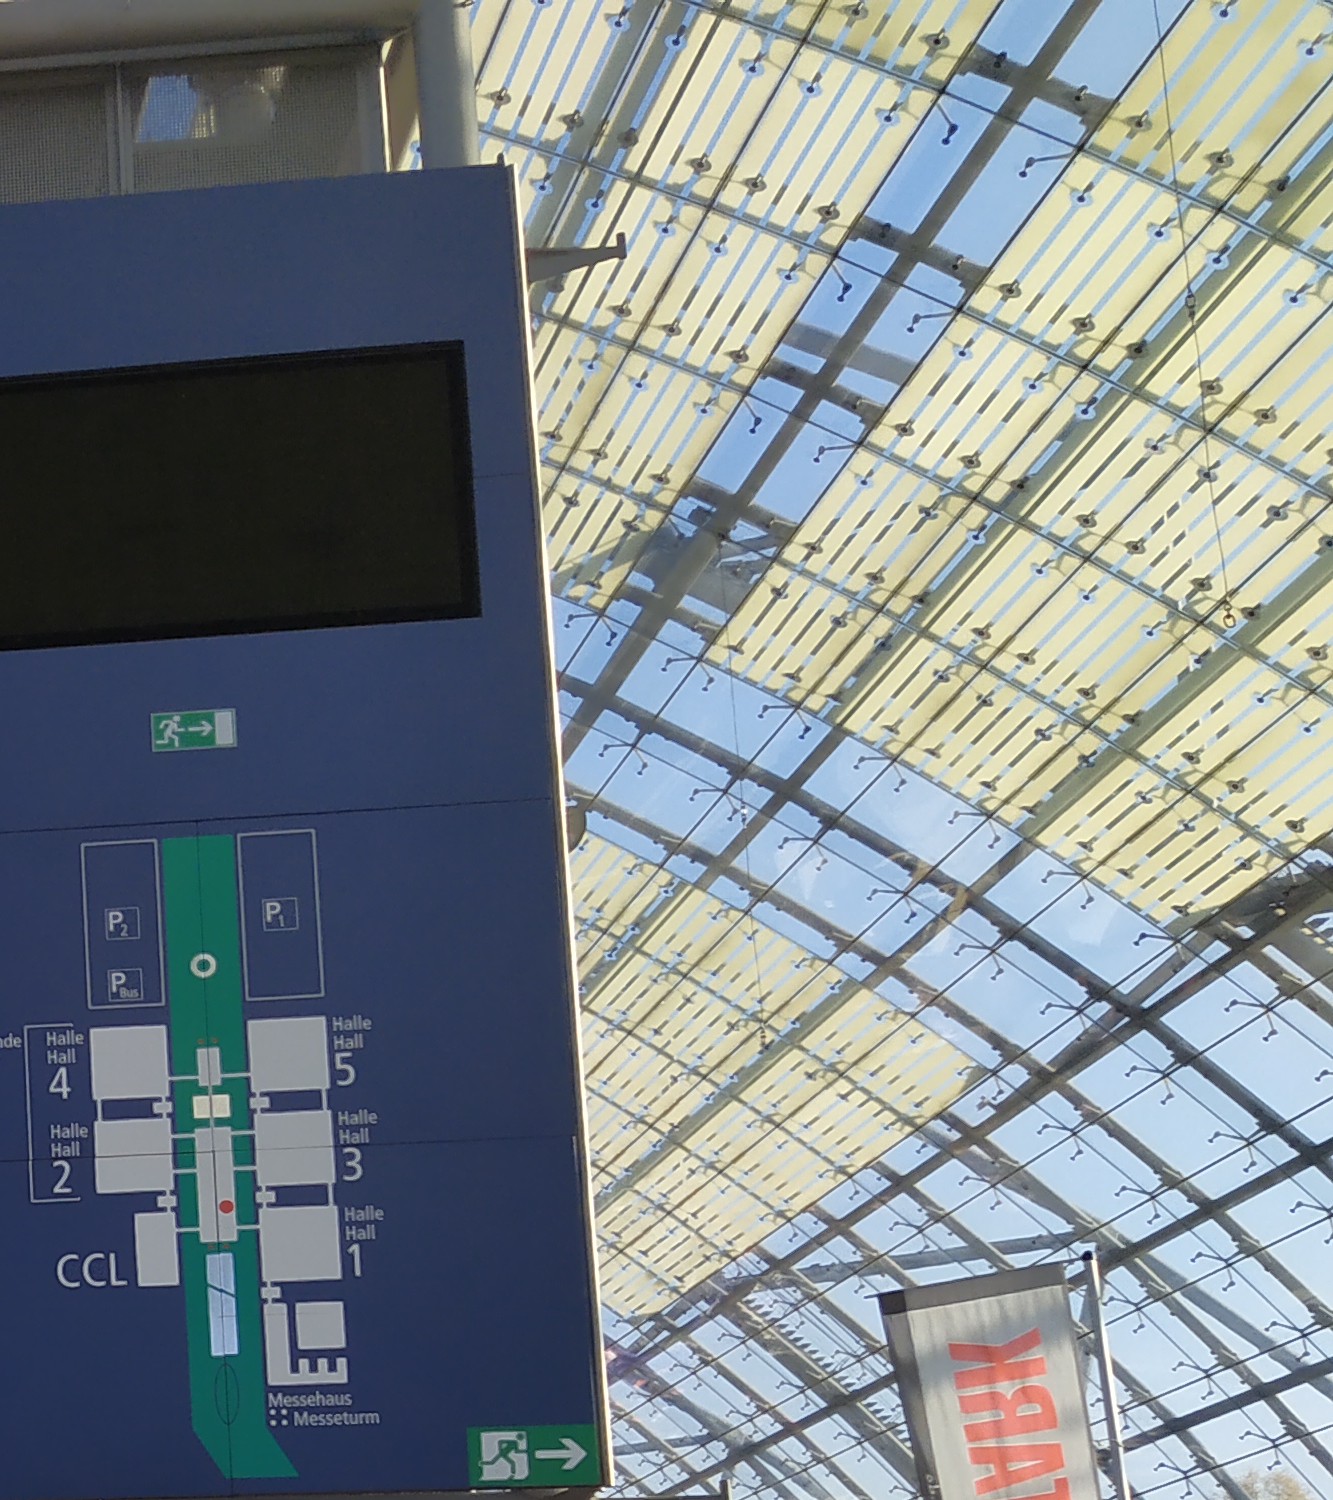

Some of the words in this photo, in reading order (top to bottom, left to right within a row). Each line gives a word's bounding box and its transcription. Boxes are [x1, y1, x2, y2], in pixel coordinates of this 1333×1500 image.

[264, 902, 285, 927] P1
[108, 911, 129, 937] P2
[332, 1014, 372, 1031] Halle
[45, 1030, 85, 1046] Halle
[333, 1033, 364, 1050] Hall
[47, 1049, 77, 1065] Hall
[334, 1052, 356, 1087] 5
[48, 1066, 72, 1100] 4
[337, 1109, 378, 1126] Halle
[50, 1123, 89, 1139] Halle
[338, 1128, 370, 1145] Hall
[51, 1142, 81, 1158] Hall
[341, 1147, 363, 1182] 3
[52, 1159, 73, 1194] 2
[344, 1205, 384, 1222] Halle
[345, 1224, 376, 1241] Hall
[346, 1243, 362, 1278] 1
[56, 1252, 129, 1289] CCL
[267, 1391, 353, 1408] Messehaus
[293, 1411, 380, 1427] Messeturm
